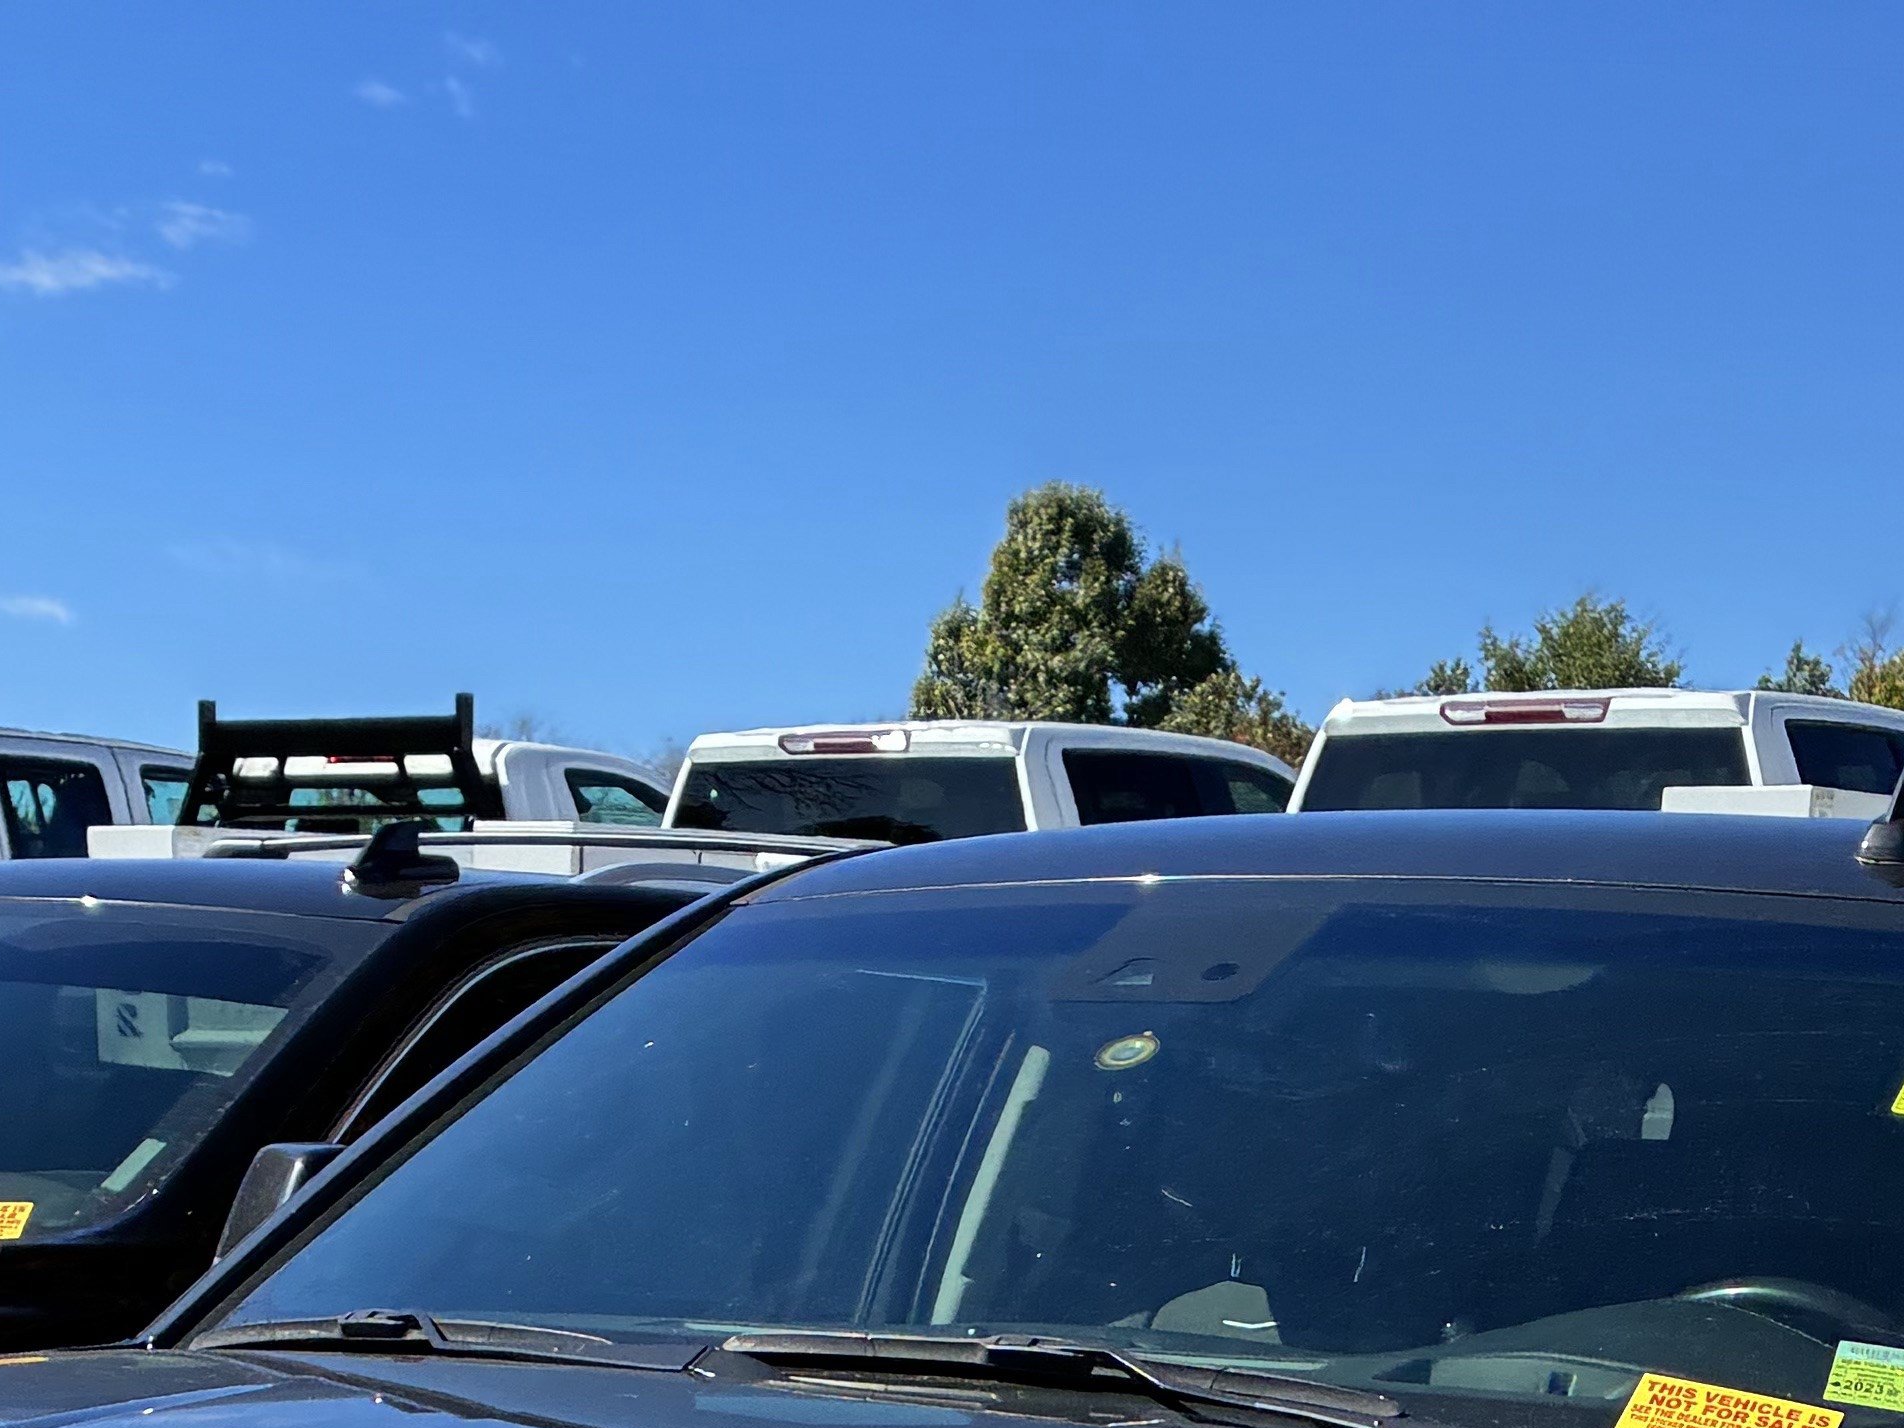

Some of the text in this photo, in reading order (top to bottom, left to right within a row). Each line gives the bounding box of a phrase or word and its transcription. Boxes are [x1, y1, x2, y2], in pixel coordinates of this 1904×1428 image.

[1843, 1380, 1884, 1394] 2023
[1648, 1380, 1831, 1428] THIS VEHICLE IS
[1649, 1394, 1698, 1412] NOT
[1702, 1404, 1750, 1423] FOR
[1655, 1408, 1675, 1419] THE
[1677, 1412, 1719, 1427] DEALER
